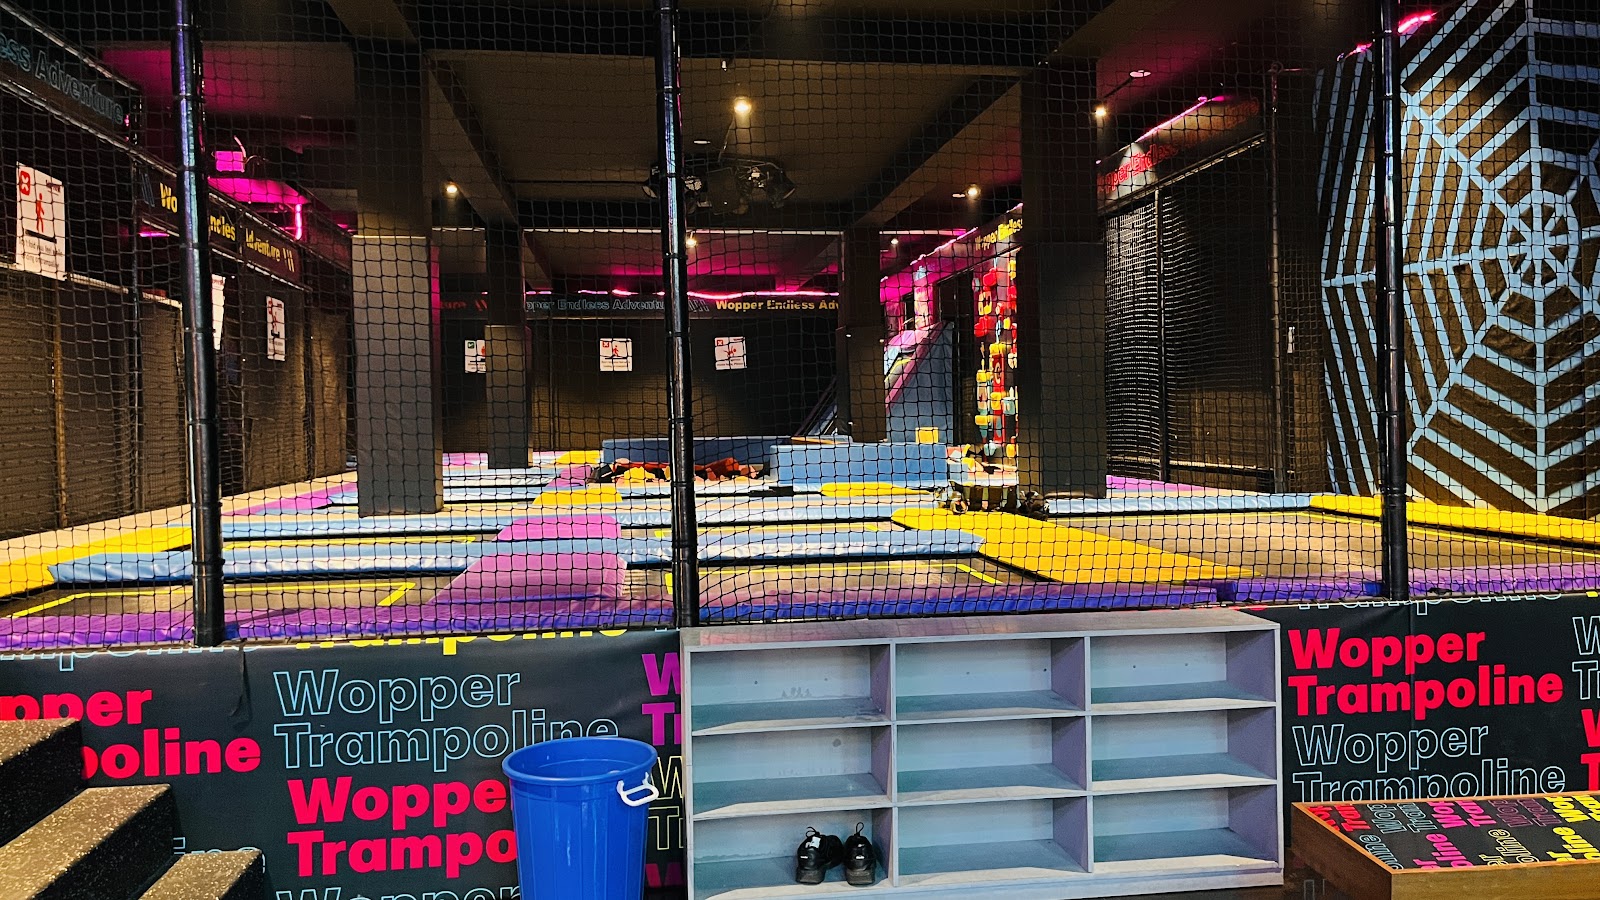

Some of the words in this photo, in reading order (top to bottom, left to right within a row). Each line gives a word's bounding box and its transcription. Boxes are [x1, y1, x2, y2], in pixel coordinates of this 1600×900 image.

[35, 49, 123, 125] Adventure
[558, 299, 610, 311] Endless
[716, 299, 764, 313] Wopper
[767, 299, 815, 310] Endless
[1287, 627, 1486, 678] Wopper
[273, 669, 521, 724] Wopper
[1287, 663, 1564, 721] Trampoline
[273, 708, 619, 773] Trampoline
[1292, 724, 1489, 774] Wopper
[287, 776, 511, 830] Woppe
[1292, 757, 1566, 803] Trampoline
